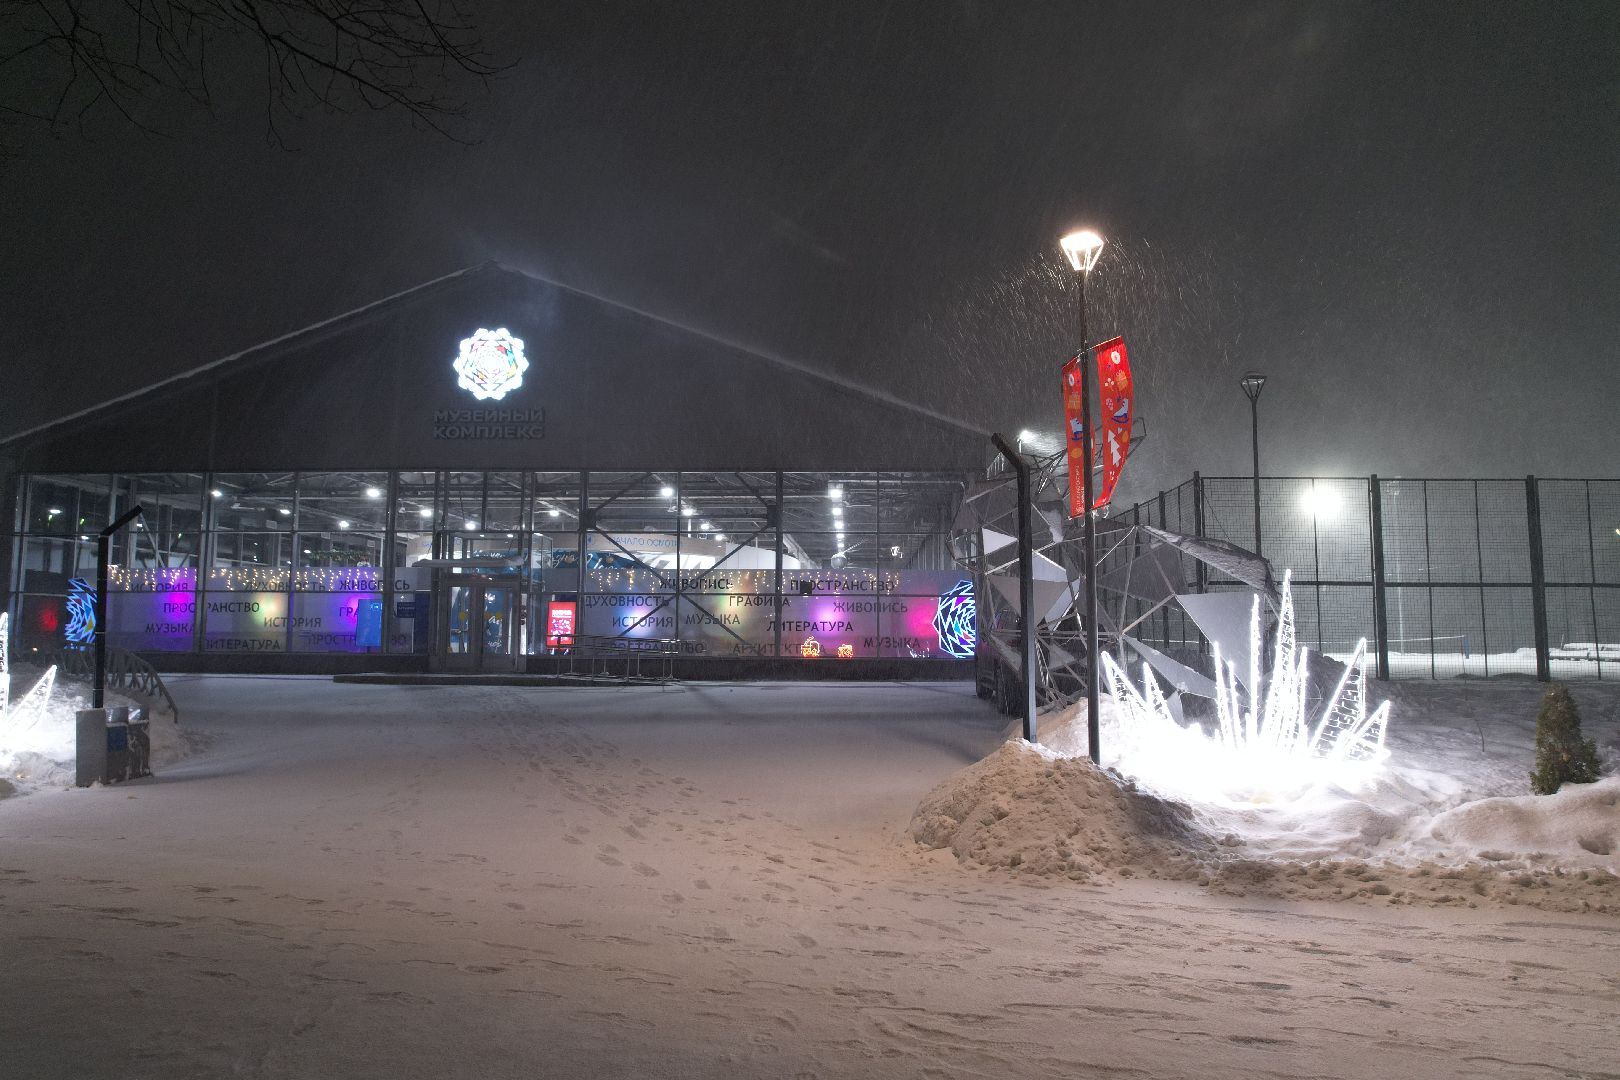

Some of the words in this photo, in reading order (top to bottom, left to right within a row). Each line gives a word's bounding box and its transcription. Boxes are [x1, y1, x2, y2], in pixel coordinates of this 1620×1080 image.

[433, 407, 545, 422] МУЗЕЙНЫЙ
[433, 425, 544, 439] КОМПЛЕКС
[131, 582, 188, 591] ИСТОРИЯ
[339, 579, 410, 590] ЖИВОПСЬ
[790, 580, 895, 591] ПОСТРАНСТВО
[729, 595, 791, 607] ГРАФИА
[163, 602, 260, 613] ПРОСРАНСТВО
[833, 602, 908, 613] ЖИВОПИСЬ
[264, 617, 322, 628] ИСТОРИЯ
[612, 616, 673, 628] ИСТОРИЯ
[686, 613, 741, 625] МУЗЫКА
[863, 637, 921, 648] МУЗЫКА
[732, 643, 827, 654] АРХИТКТА
